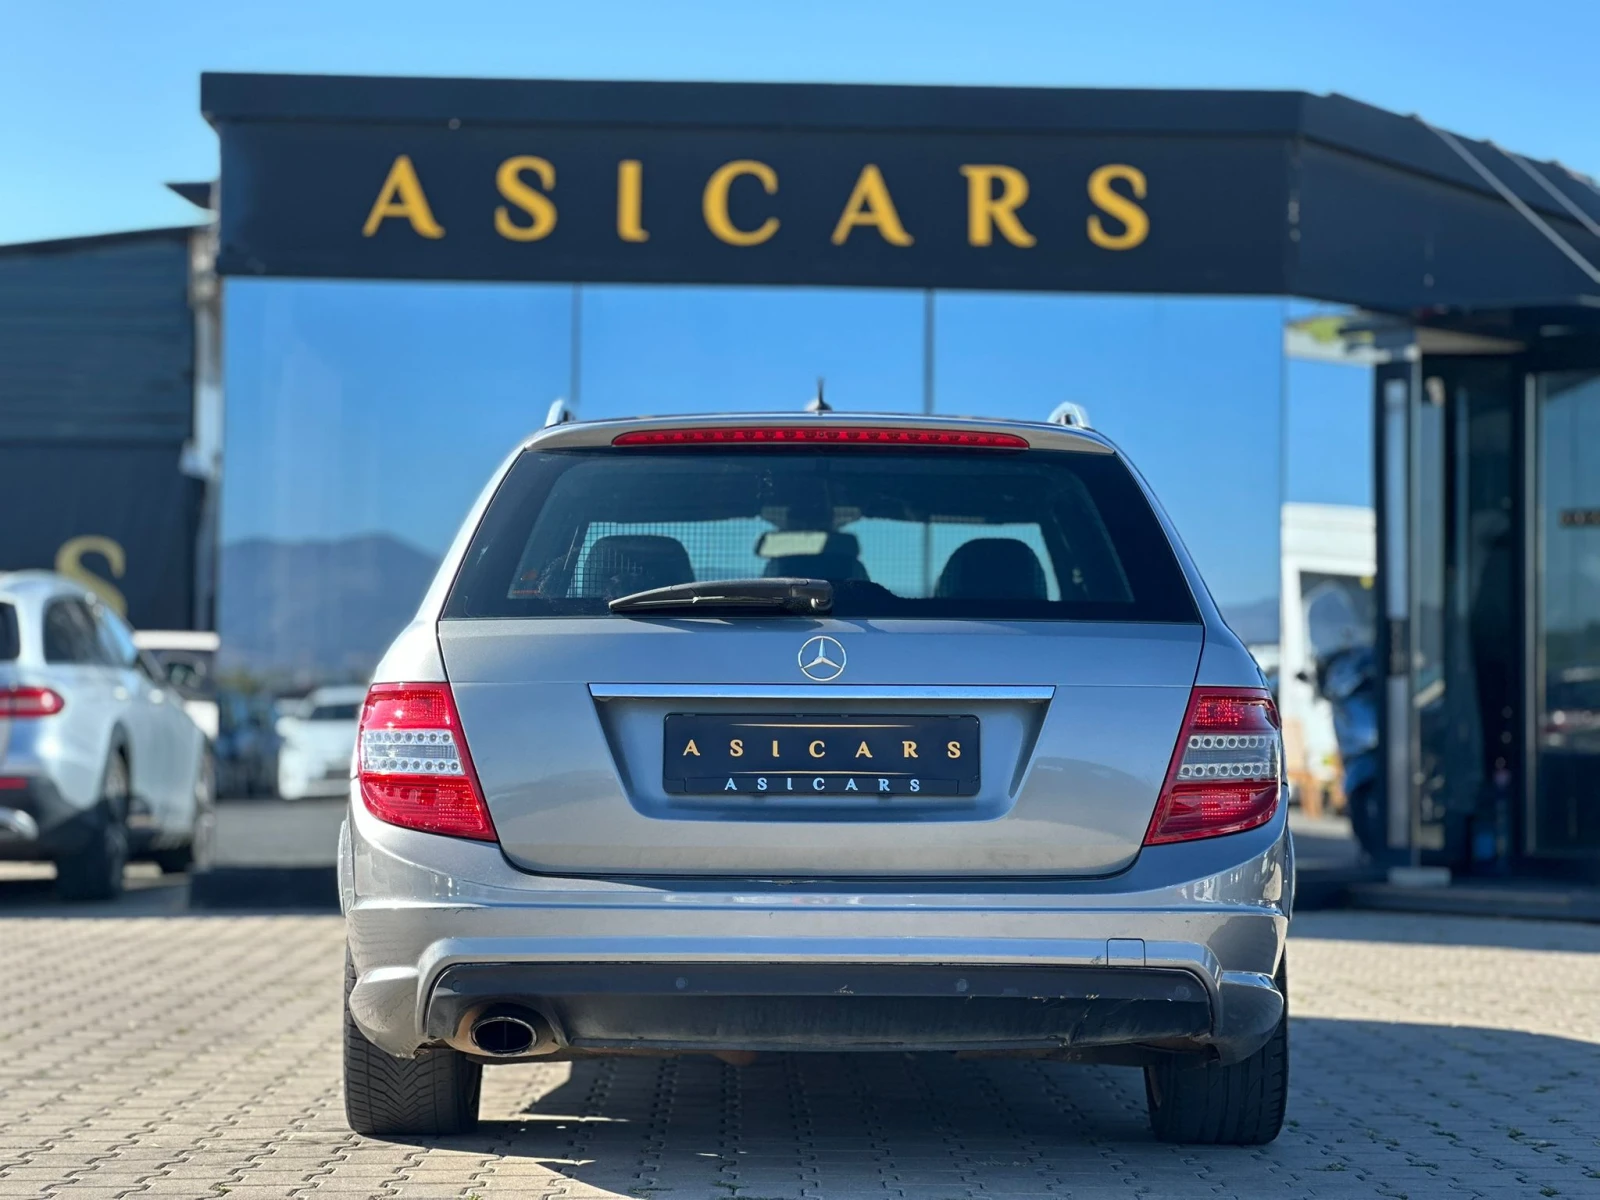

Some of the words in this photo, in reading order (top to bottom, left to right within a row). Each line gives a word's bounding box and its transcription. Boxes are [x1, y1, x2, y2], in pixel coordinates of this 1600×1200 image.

[363, 154, 1151, 251] ASICARS
[683, 739, 961, 759] ASICARS
[724, 777, 920, 792] ASICARS
